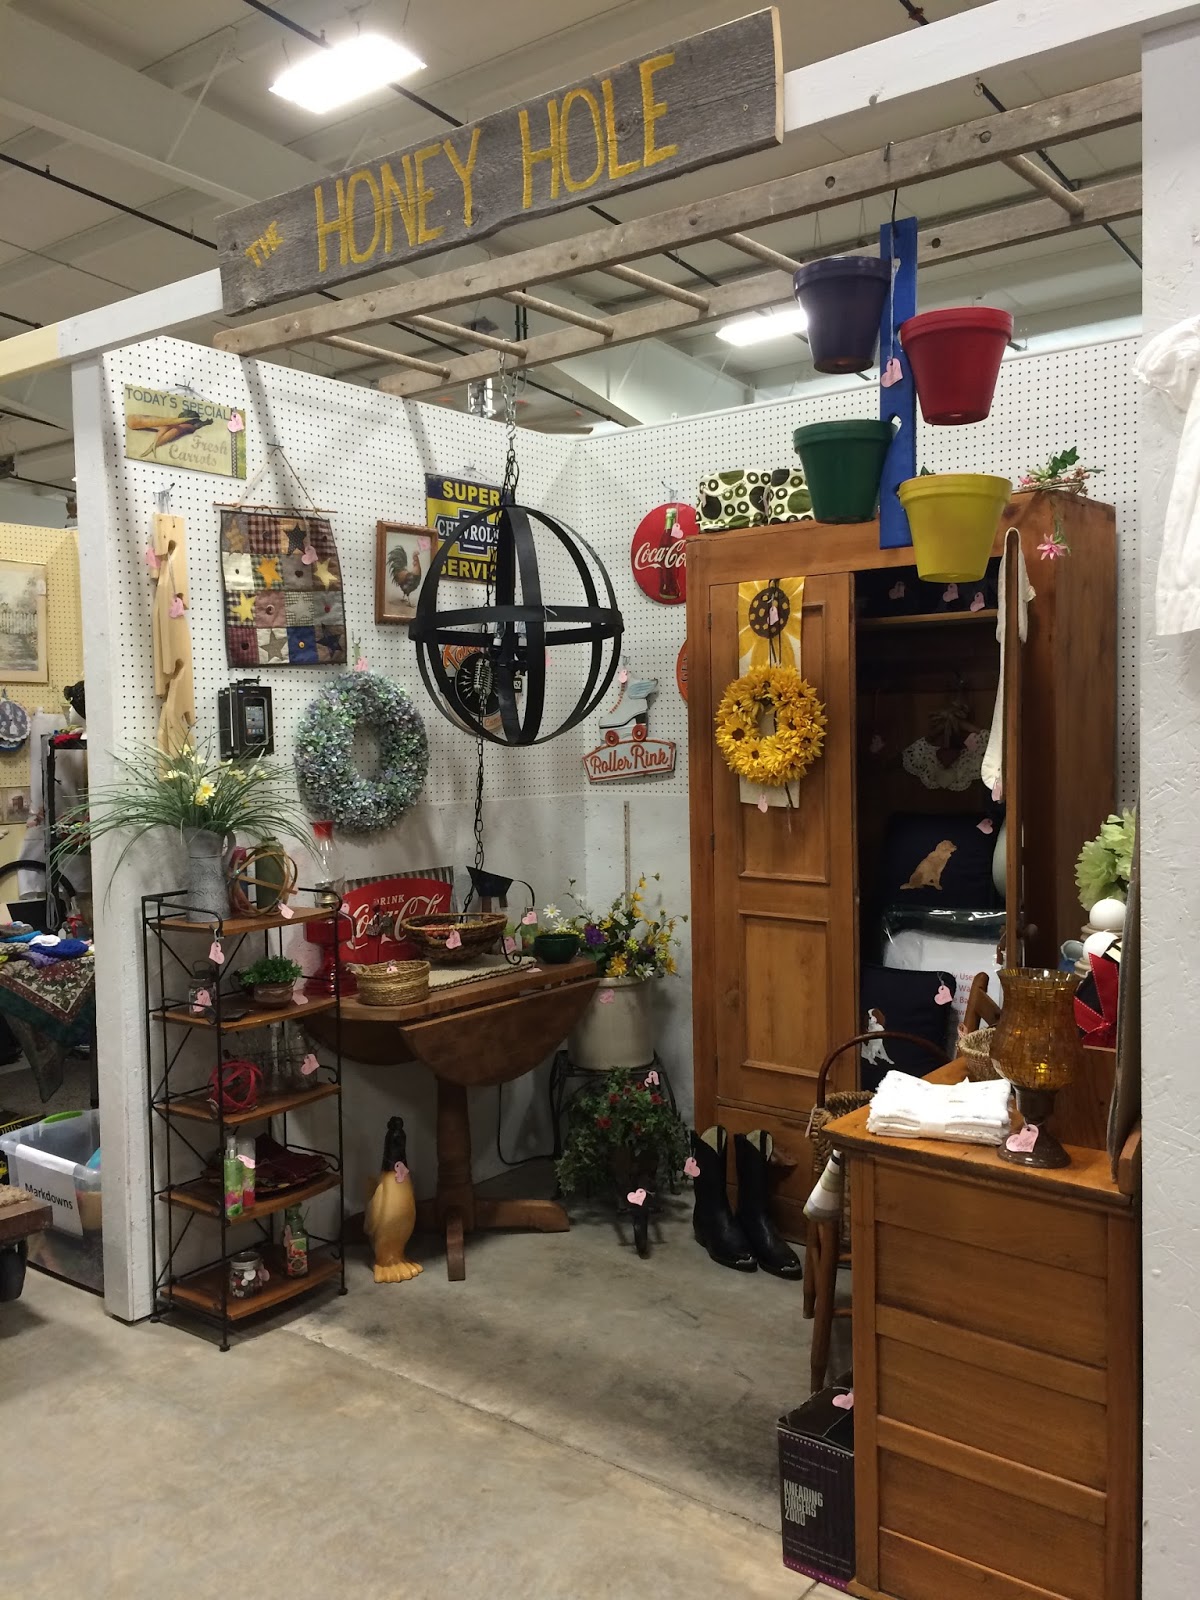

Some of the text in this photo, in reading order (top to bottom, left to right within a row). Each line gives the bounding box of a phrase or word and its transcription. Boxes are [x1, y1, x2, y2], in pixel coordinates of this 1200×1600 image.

[245, 53, 679, 272] THE HONEY HOLE
[125, 387, 233, 421] TODAY'S SPECIAL
[168, 444, 218, 467] Carrots
[191, 435, 228, 455] Fresh
[442, 481, 500, 506] SUPER
[437, 519, 500, 544] CHVROL
[634, 539, 687, 570] Coca-Co
[440, 558, 497, 581] ERVI
[590, 743, 669, 775] Roller Rink
[24, 1182, 74, 1210] Markdowns
[783, 1478, 824, 1508] KNEADING
[784, 1492, 817, 1518] FINGERS
[784, 1506, 806, 1527] 2000
